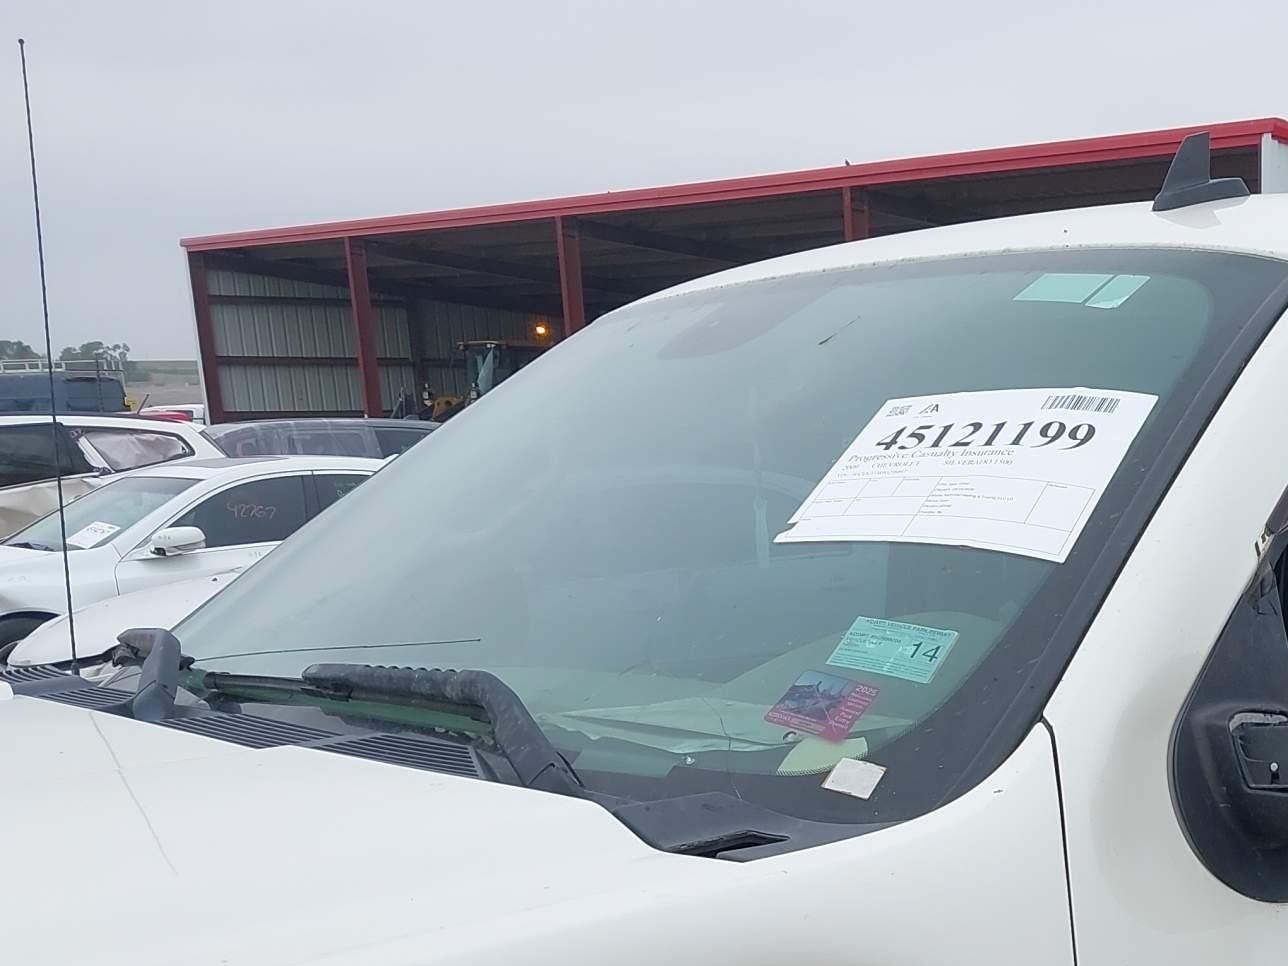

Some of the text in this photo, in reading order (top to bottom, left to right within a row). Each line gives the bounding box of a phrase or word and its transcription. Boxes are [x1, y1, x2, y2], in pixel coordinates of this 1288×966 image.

[875, 420, 1097, 451] 45121199
[849, 448, 1016, 463] Progressive Casualty Insurance
[909, 640, 942, 663] 14
